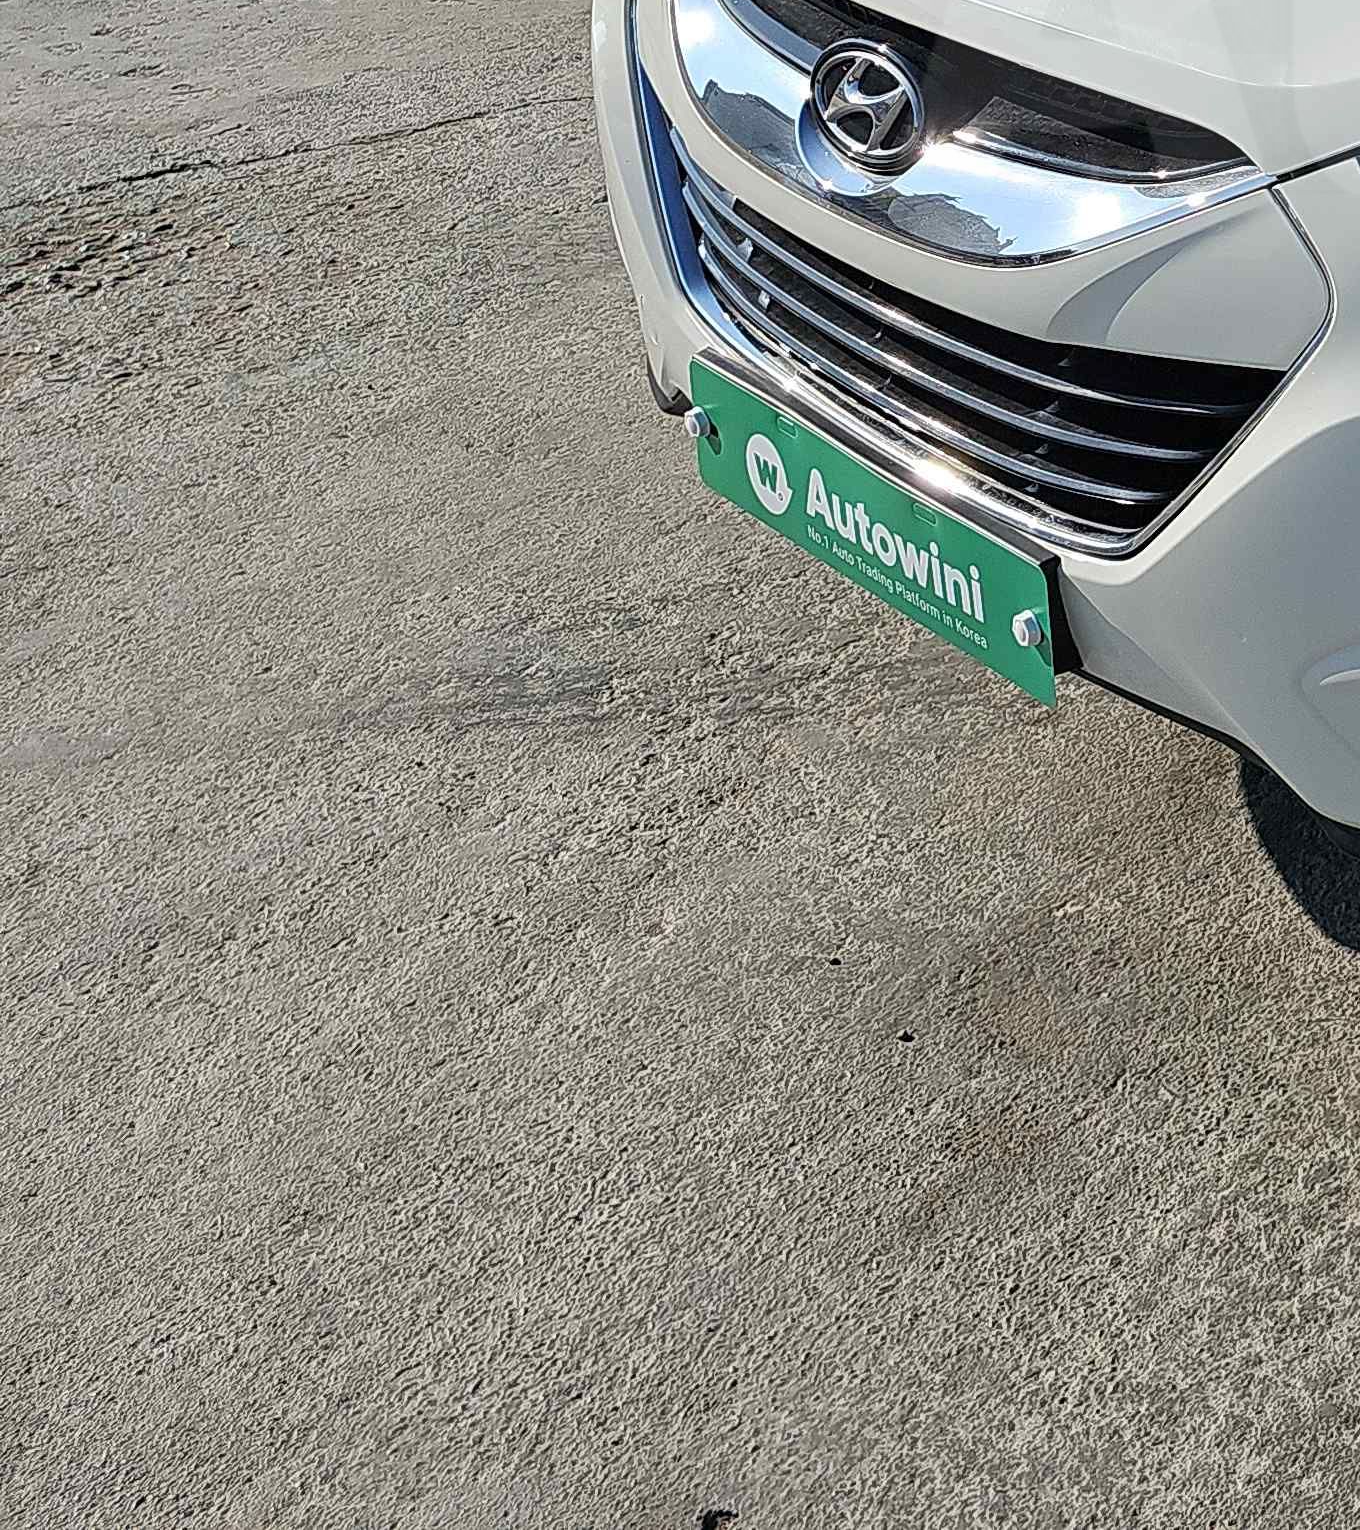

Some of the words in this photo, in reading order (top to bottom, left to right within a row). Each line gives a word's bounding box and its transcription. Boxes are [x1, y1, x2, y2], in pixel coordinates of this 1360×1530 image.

[806, 467, 985, 624] Autowini
[807, 524, 830, 548] No.1
[832, 541, 855, 566] Auto
[856, 555, 895, 594] Trading
[895, 580, 941, 621] Platform
[942, 610, 954, 629] in
[954, 618, 988, 650] Korea
